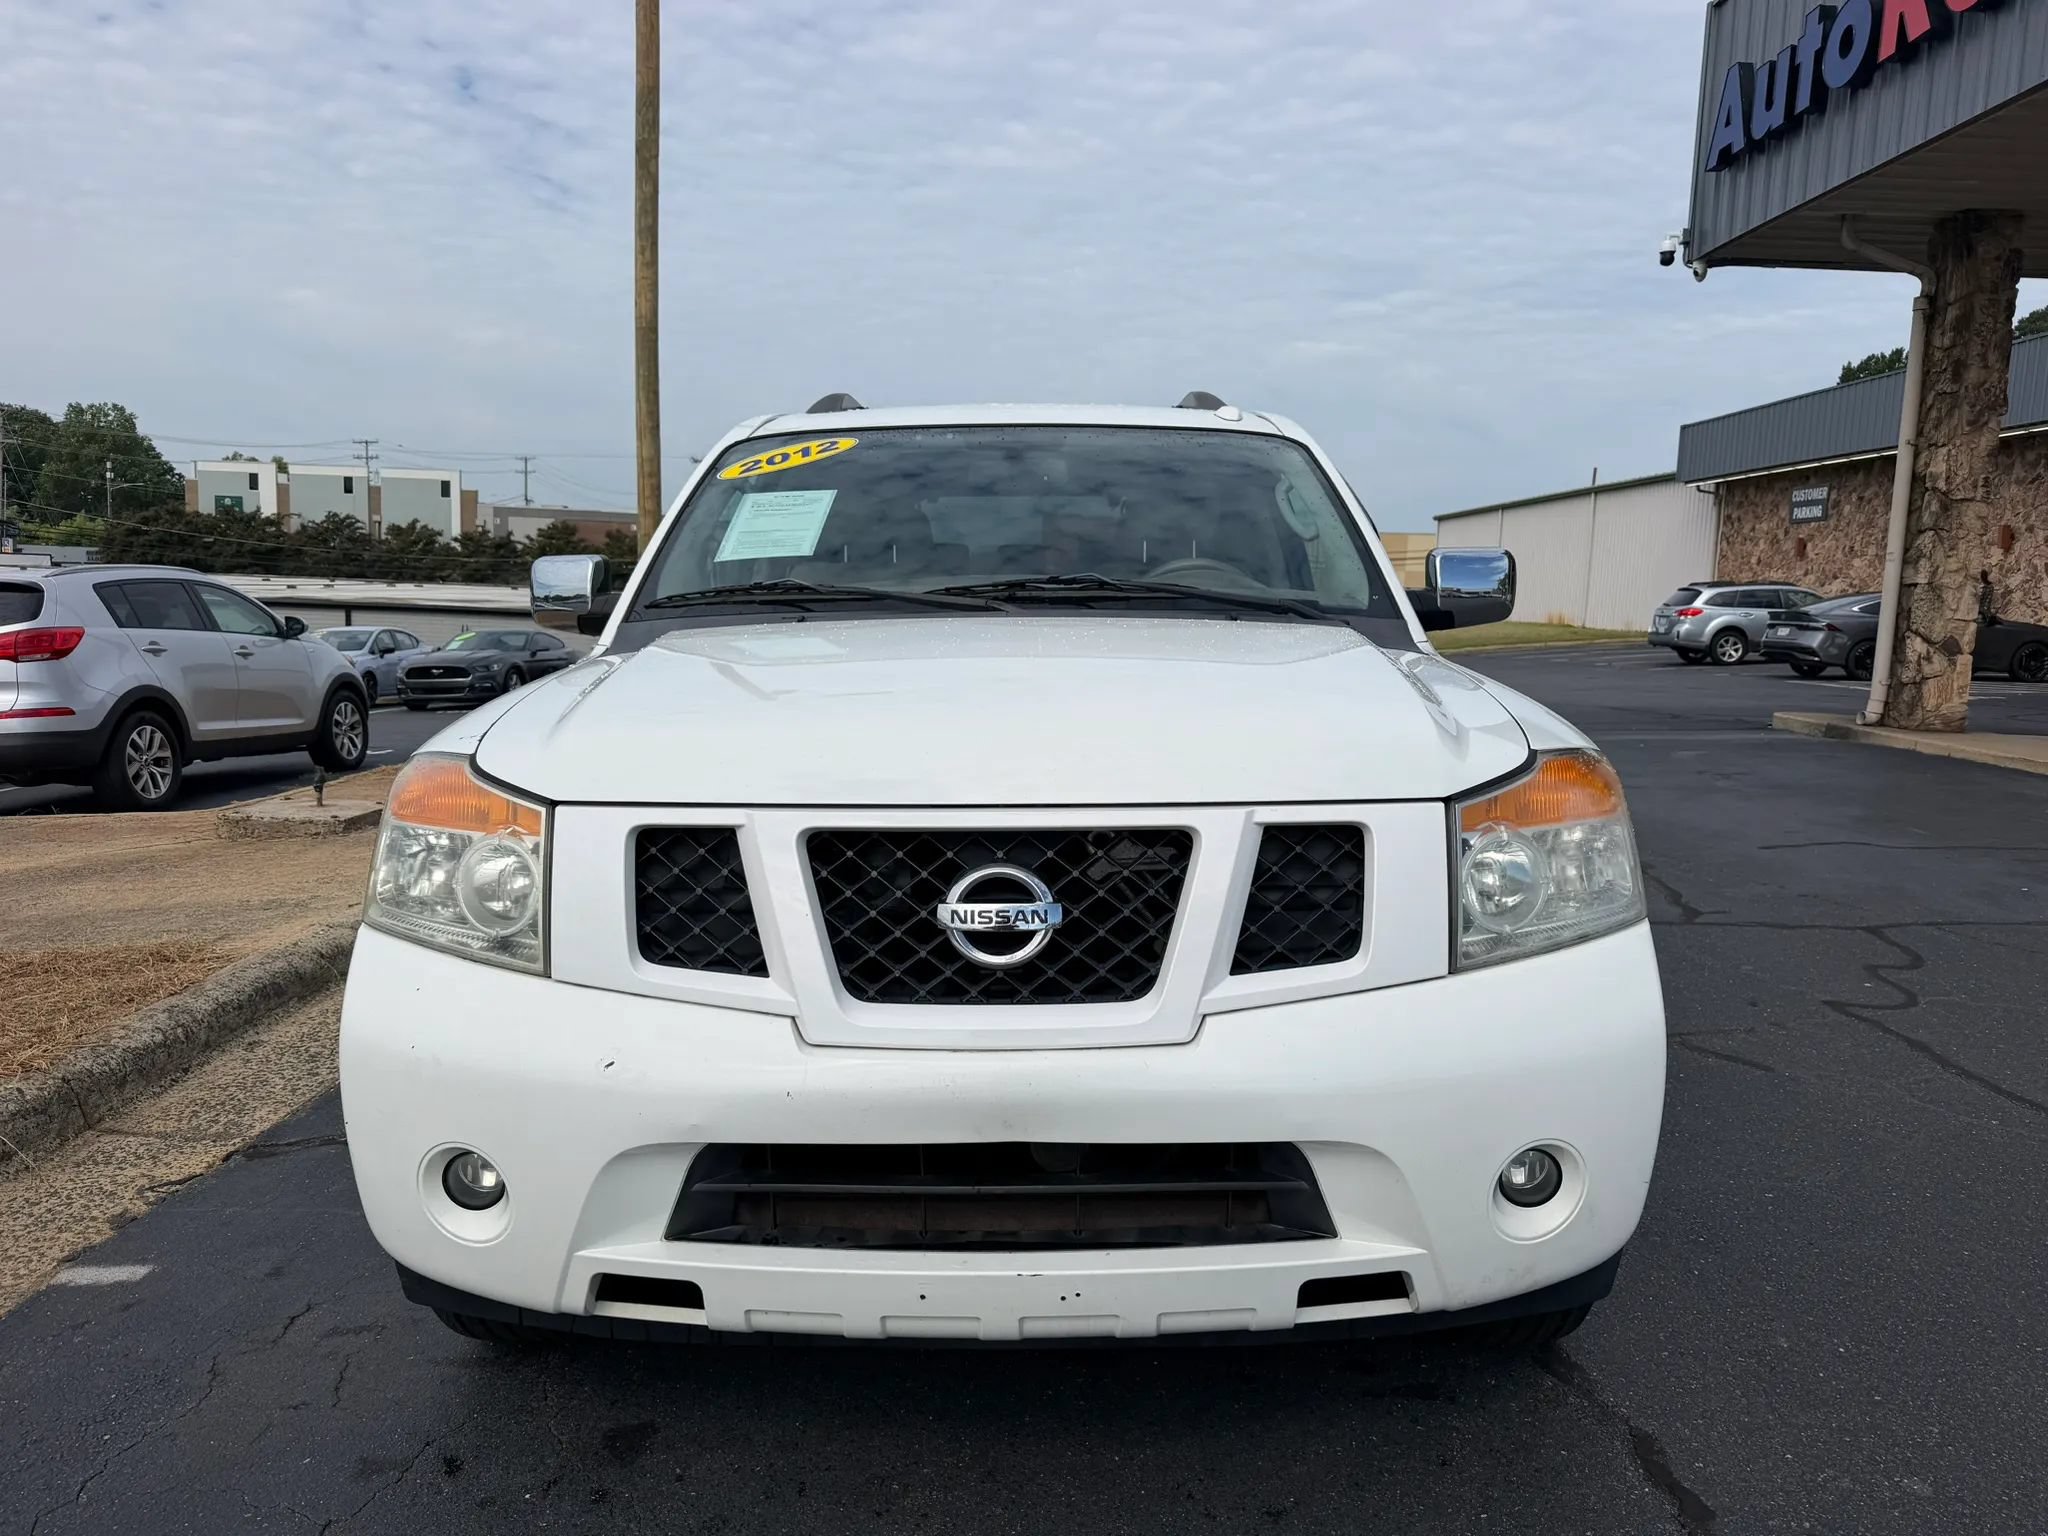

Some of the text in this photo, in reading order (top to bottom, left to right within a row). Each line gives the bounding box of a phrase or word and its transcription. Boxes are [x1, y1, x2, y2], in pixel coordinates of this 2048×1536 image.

[738, 440, 841, 476] 2012
[1792, 486, 1828, 502] CUSTOMER
[1792, 505, 1822, 519] PARKING
[950, 909, 1049, 925] NISSAN
